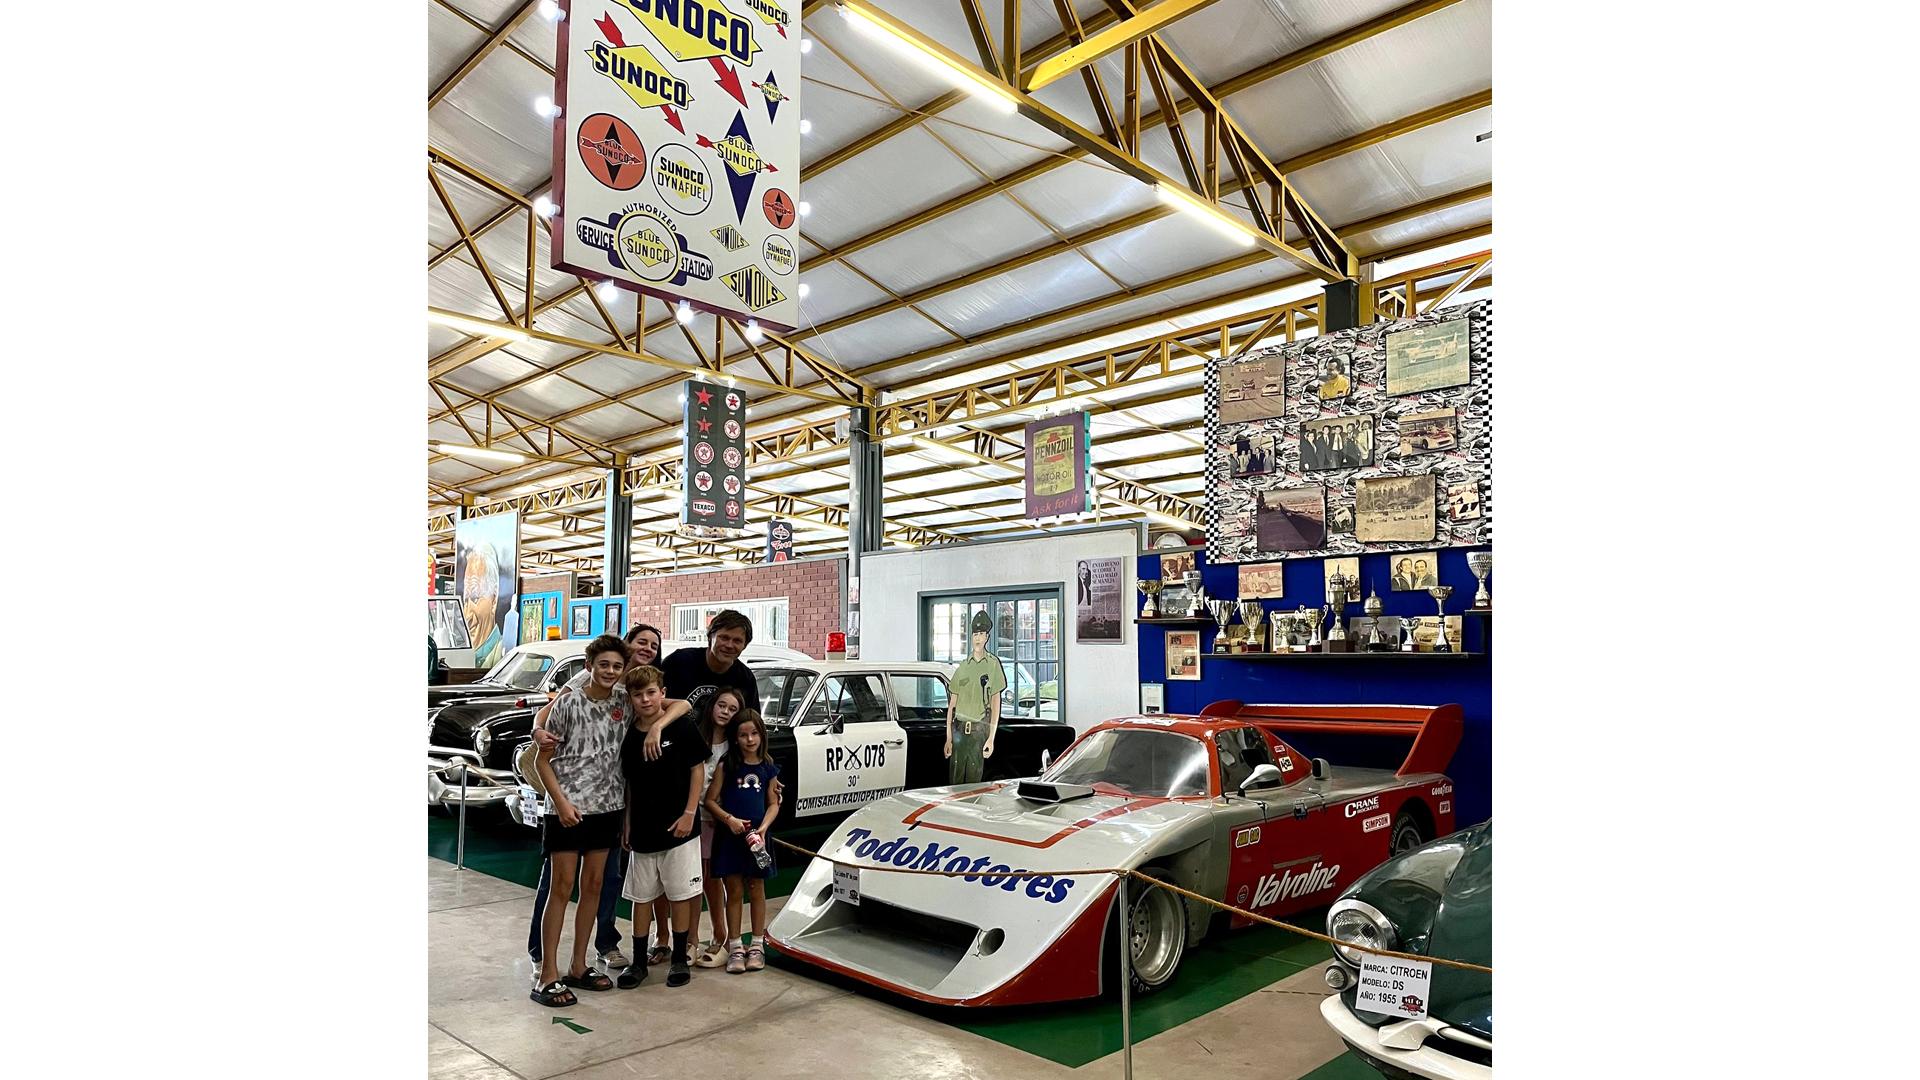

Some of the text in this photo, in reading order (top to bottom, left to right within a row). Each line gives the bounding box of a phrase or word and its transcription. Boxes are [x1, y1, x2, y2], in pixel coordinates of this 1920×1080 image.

[628, 0, 750, 62] NOCO
[594, 42, 686, 108] SUNOCO
[597, 146, 630, 163] SUNOCO
[604, 141, 622, 150] BLUE
[728, 137, 752, 154] BLUE
[717, 143, 762, 173] SUNOCO
[660, 156, 704, 184] SUNOCO
[658, 172, 708, 202] DYNAFUEL
[622, 202, 678, 233] AUTHORIZED
[578, 224, 614, 248] SERVICE
[638, 230, 660, 244] BLUE
[716, 227, 746, 250] SUNOILS
[627, 238, 670, 264] SUNOCO
[766, 250, 792, 268] DYNAFUEL
[768, 242, 791, 258] SUNOCO
[681, 256, 712, 278] STATION
[730, 268, 778, 308] SUNOILS
[1035, 437, 1074, 458] PENNZOIL
[694, 503, 714, 511] TEXACO
[1032, 494, 1078, 516] Ask for it
[689, 688, 706, 703] JACK
[826, 744, 885, 772] RP 078
[796, 795, 840, 811] COMISARIA
[1344, 796, 1380, 818] CRANE
[1365, 816, 1388, 830] SIMPSON
[846, 828, 1075, 904] TodoMotores
[1250, 862, 1340, 910] Valvoline
[1364, 964, 1428, 980] MARCA: CITROEN
[1362, 977, 1404, 990] MODELO: DS
[1360, 992, 1376, 1000] AÑO:
[1378, 992, 1396, 1004] 1955
